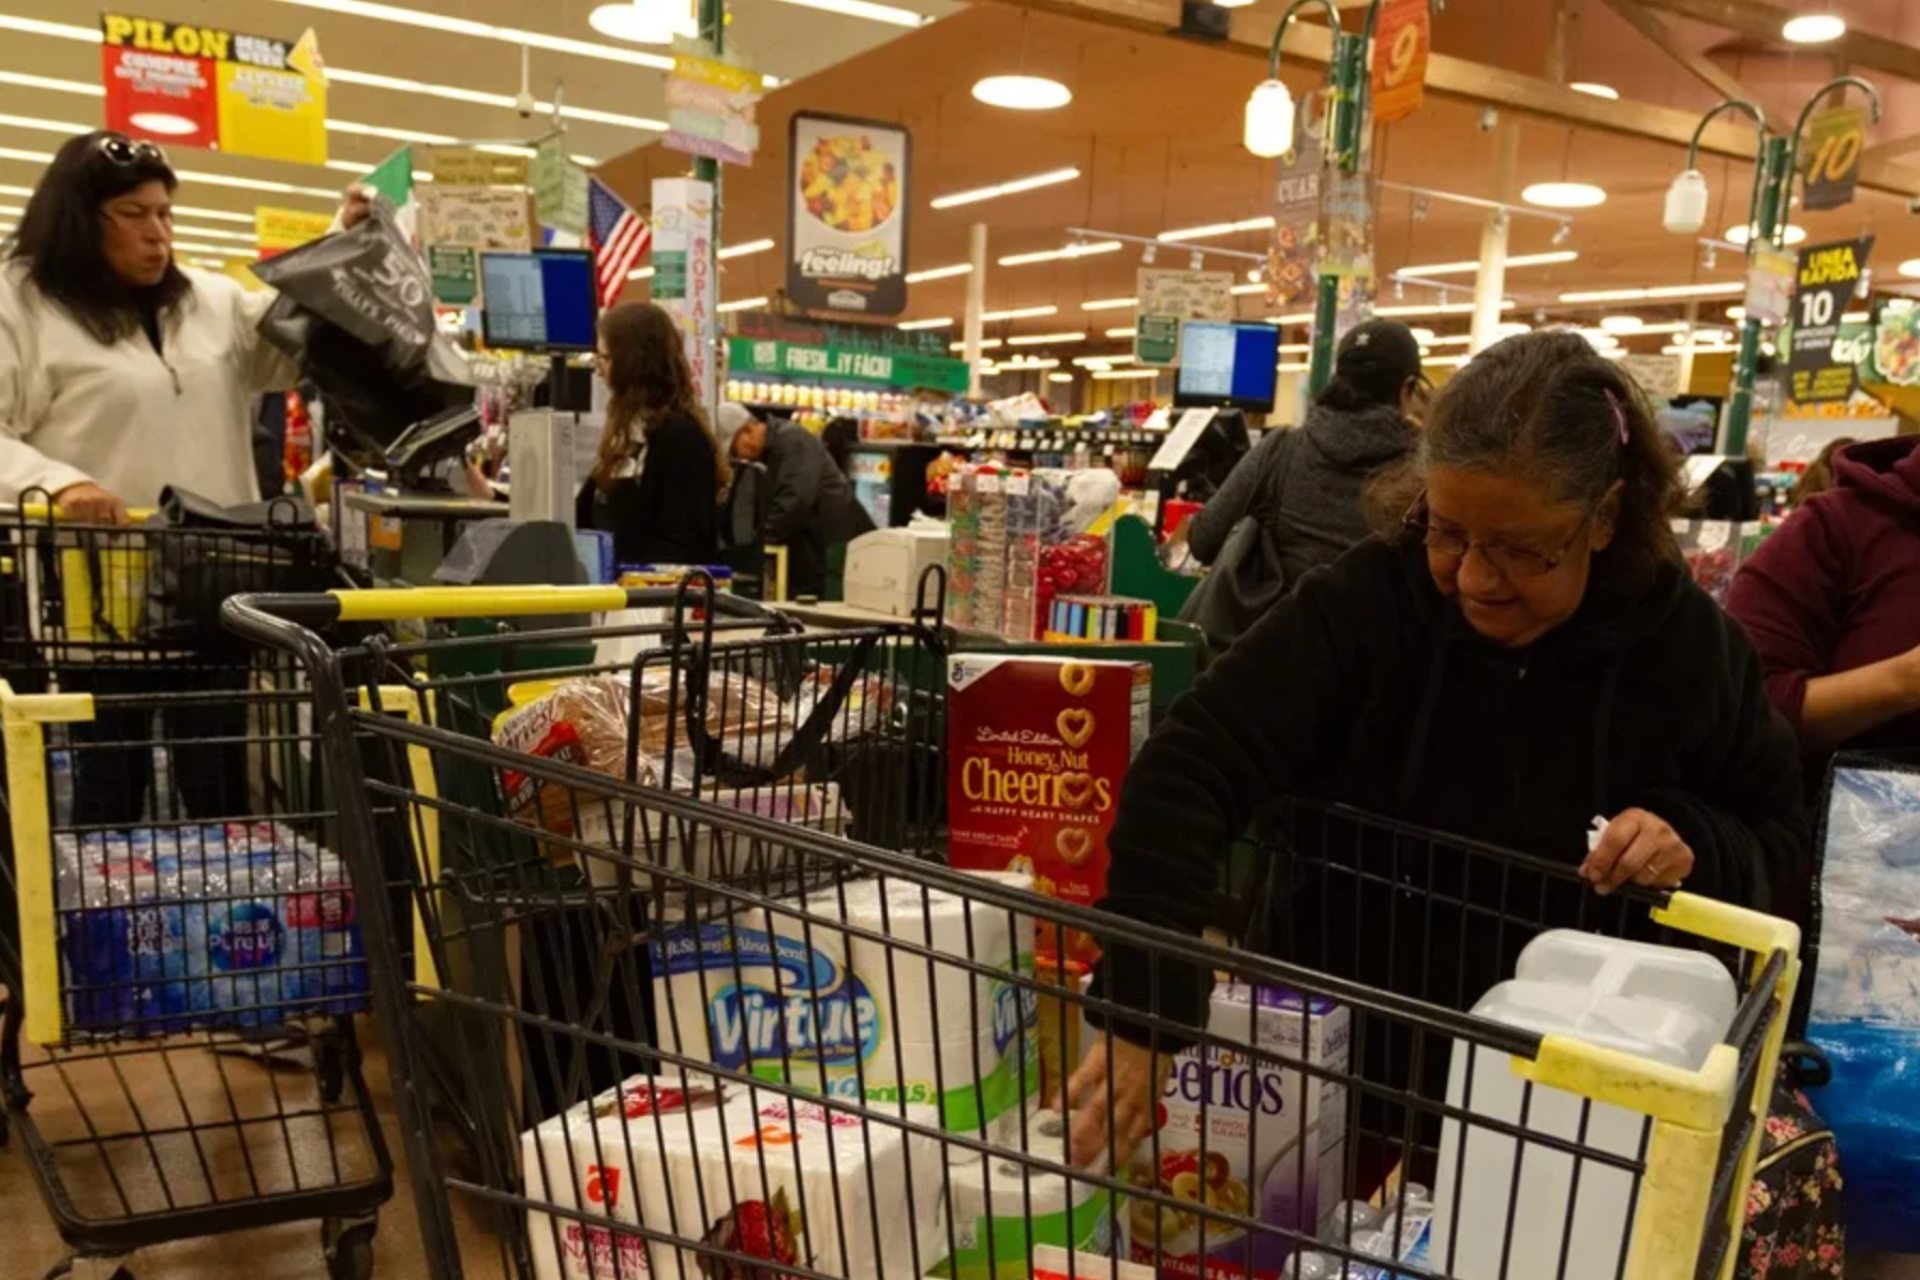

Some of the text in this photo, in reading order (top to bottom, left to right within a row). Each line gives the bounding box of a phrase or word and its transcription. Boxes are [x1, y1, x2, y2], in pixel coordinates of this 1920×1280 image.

[103, 14, 230, 60] PILON
[1384, 23, 1418, 87] 9
[1807, 131, 1862, 184] 10
[801, 250, 891, 281] feeling!
[1801, 289, 1834, 328] 10
[1007, 746, 1089, 772] Honey Nut
[985, 807, 1017, 817] HAPPY
[1020, 810, 1054, 821] HEART
[1058, 813, 1100, 825] SHAPES
[713, 992, 875, 1055] Virtue
[563, 1242, 648, 1271] NAPKNS
